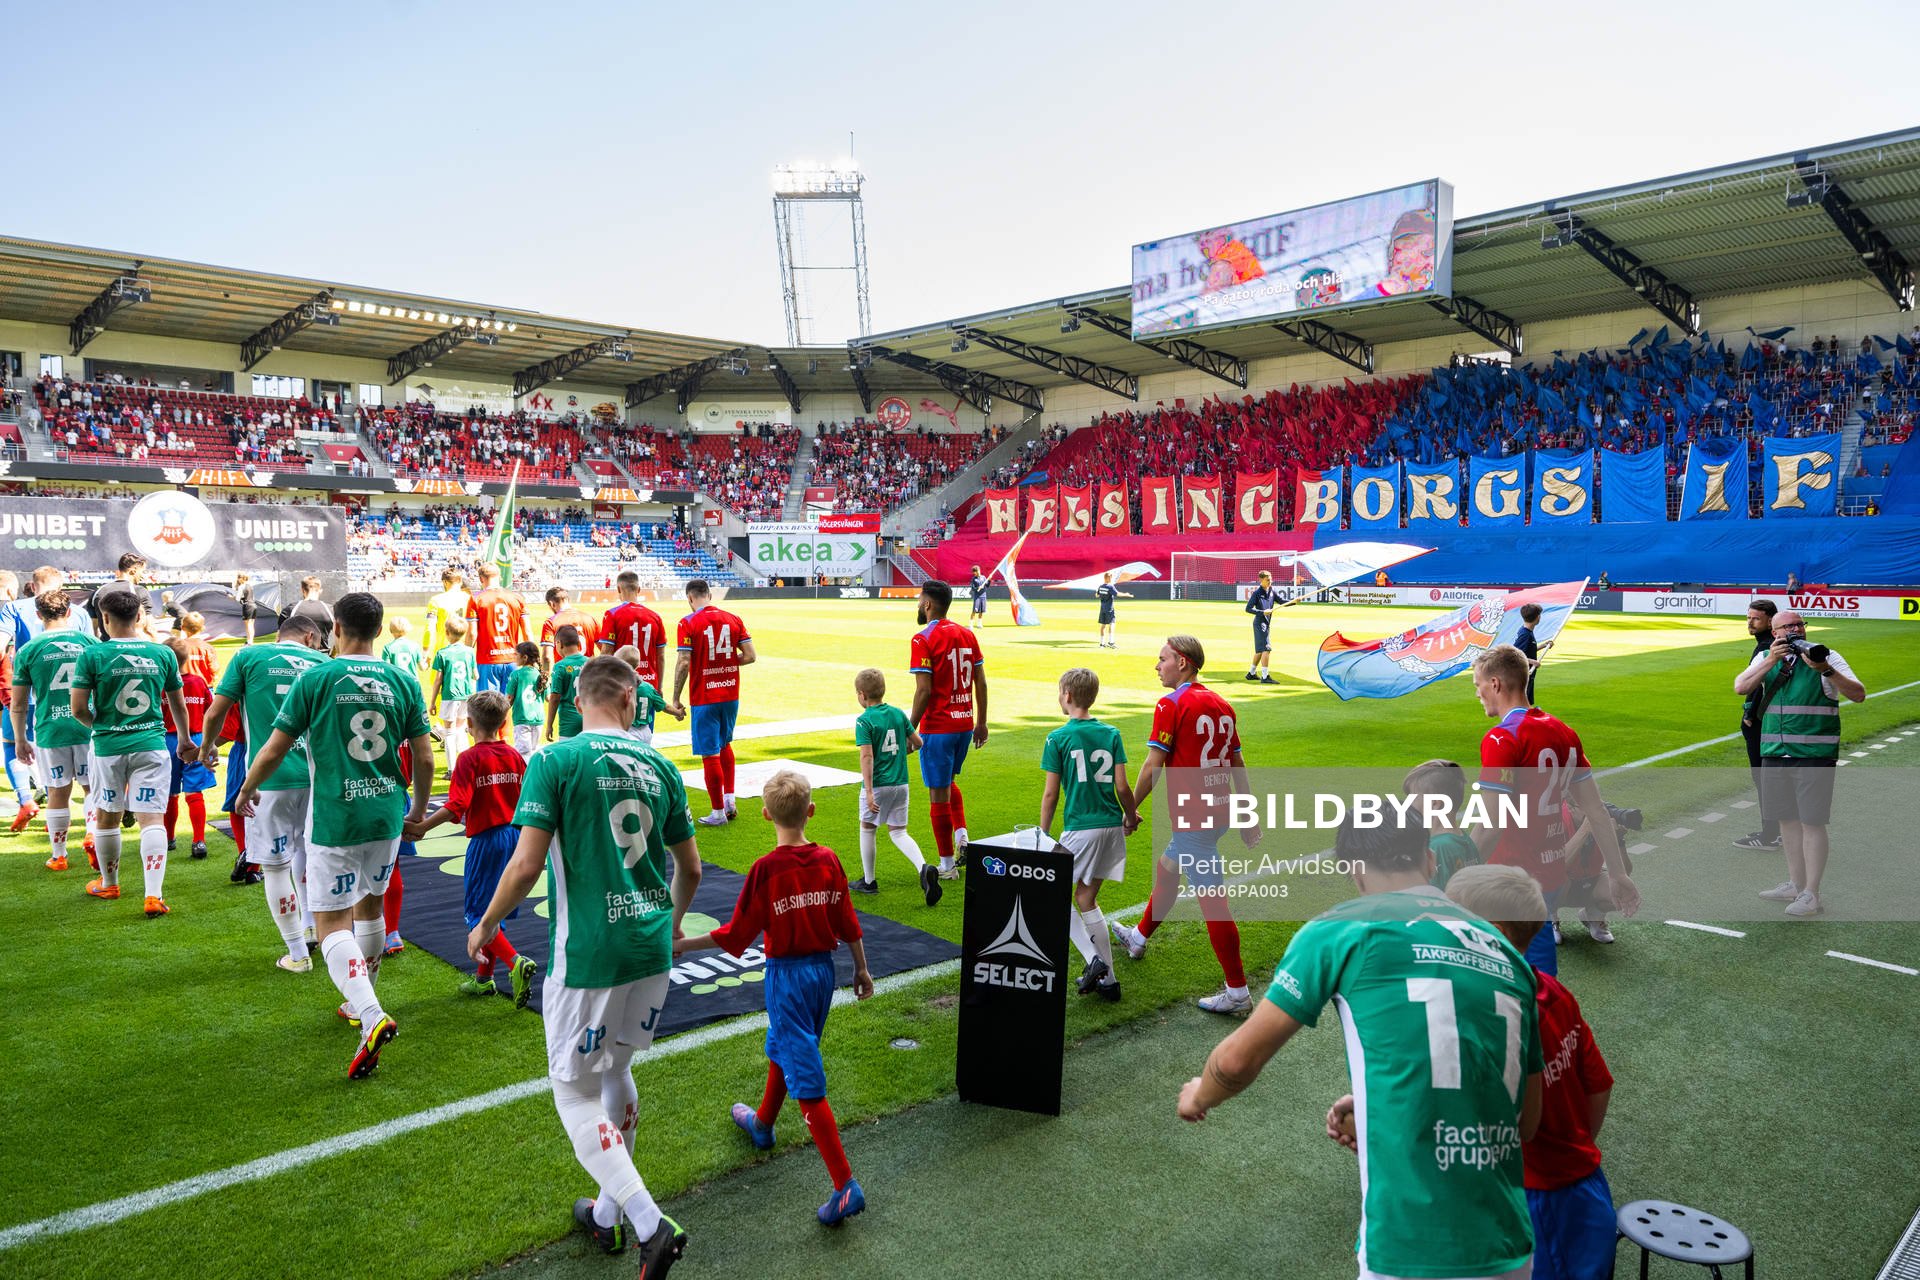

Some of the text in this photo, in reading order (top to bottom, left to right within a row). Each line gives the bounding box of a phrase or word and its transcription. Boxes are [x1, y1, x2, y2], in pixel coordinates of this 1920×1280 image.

[1295, 276, 1319, 290] och
[235, 519, 329, 540] UNIBET
[758, 536, 833, 562] akea
[1442, 591, 1485, 600] AllOffice
[1654, 594, 1713, 610] granitor
[703, 624, 734, 661] 14
[346, 665, 385, 674] ADRIAN
[947, 648, 973, 691] 15
[706, 679, 736, 689] tillmobil
[115, 679, 151, 716] 6
[348, 710, 388, 762] 8
[881, 729, 899, 756] 4
[1196, 714, 1234, 769] 22
[1070, 749, 1114, 784] 12
[136, 787, 156, 802] JP
[271, 834, 288, 854] JP
[609, 799, 655, 869] 9
[331, 872, 356, 896] JP
[1009, 864, 1056, 882] OBOS
[831, 891, 841, 905] IF
[1412, 947, 1514, 979] TAKPROFFSEN AB
[974, 961, 1056, 993] SELECT
[1406, 977, 1522, 1105] 11
